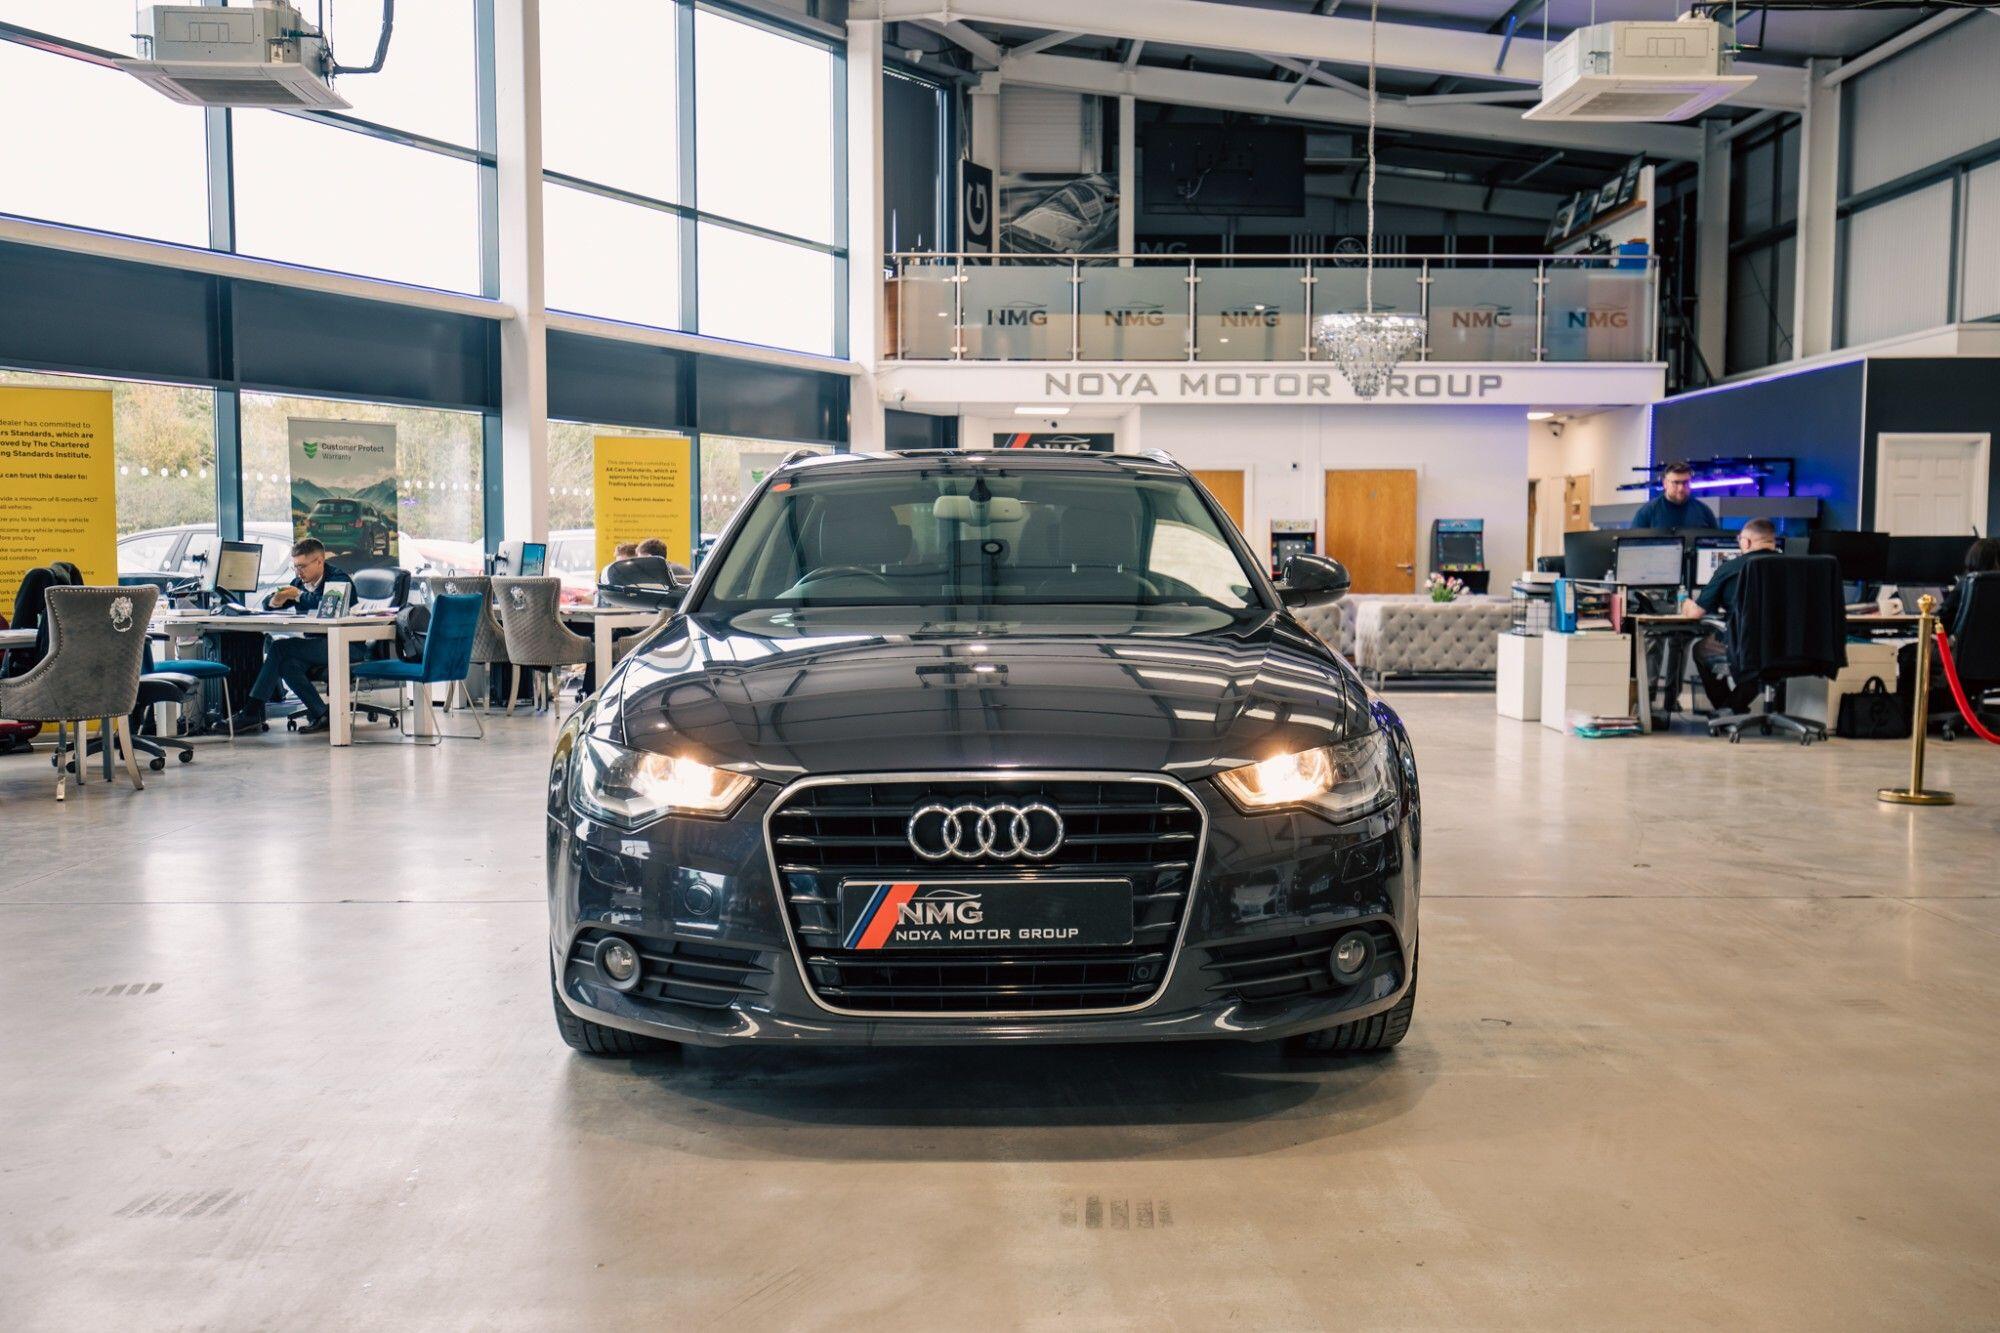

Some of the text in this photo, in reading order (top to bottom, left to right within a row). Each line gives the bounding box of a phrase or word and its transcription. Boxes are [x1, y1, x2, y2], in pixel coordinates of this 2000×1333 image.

[987, 309, 1047, 326] NMG
[1104, 310, 1165, 326] NMG
[1220, 311, 1281, 327] NMG
[1568, 311, 1628, 328] NMG
[1045, 373, 1502, 397] NOYA MOTOR ROUP
[39, 421, 81, 429] committed
[10, 429, 55, 438] Standards,
[22, 440, 32, 448] by
[50, 441, 90, 449] Chartered
[321, 442, 384, 453] Customer Protect
[13, 450, 54, 458] Standards
[56, 451, 92, 459] Institute.
[322, 453, 352, 461] Warranty
[897, 901, 983, 925] NMG
[896, 928, 1079, 941] NOYA MOTOR GROUP
